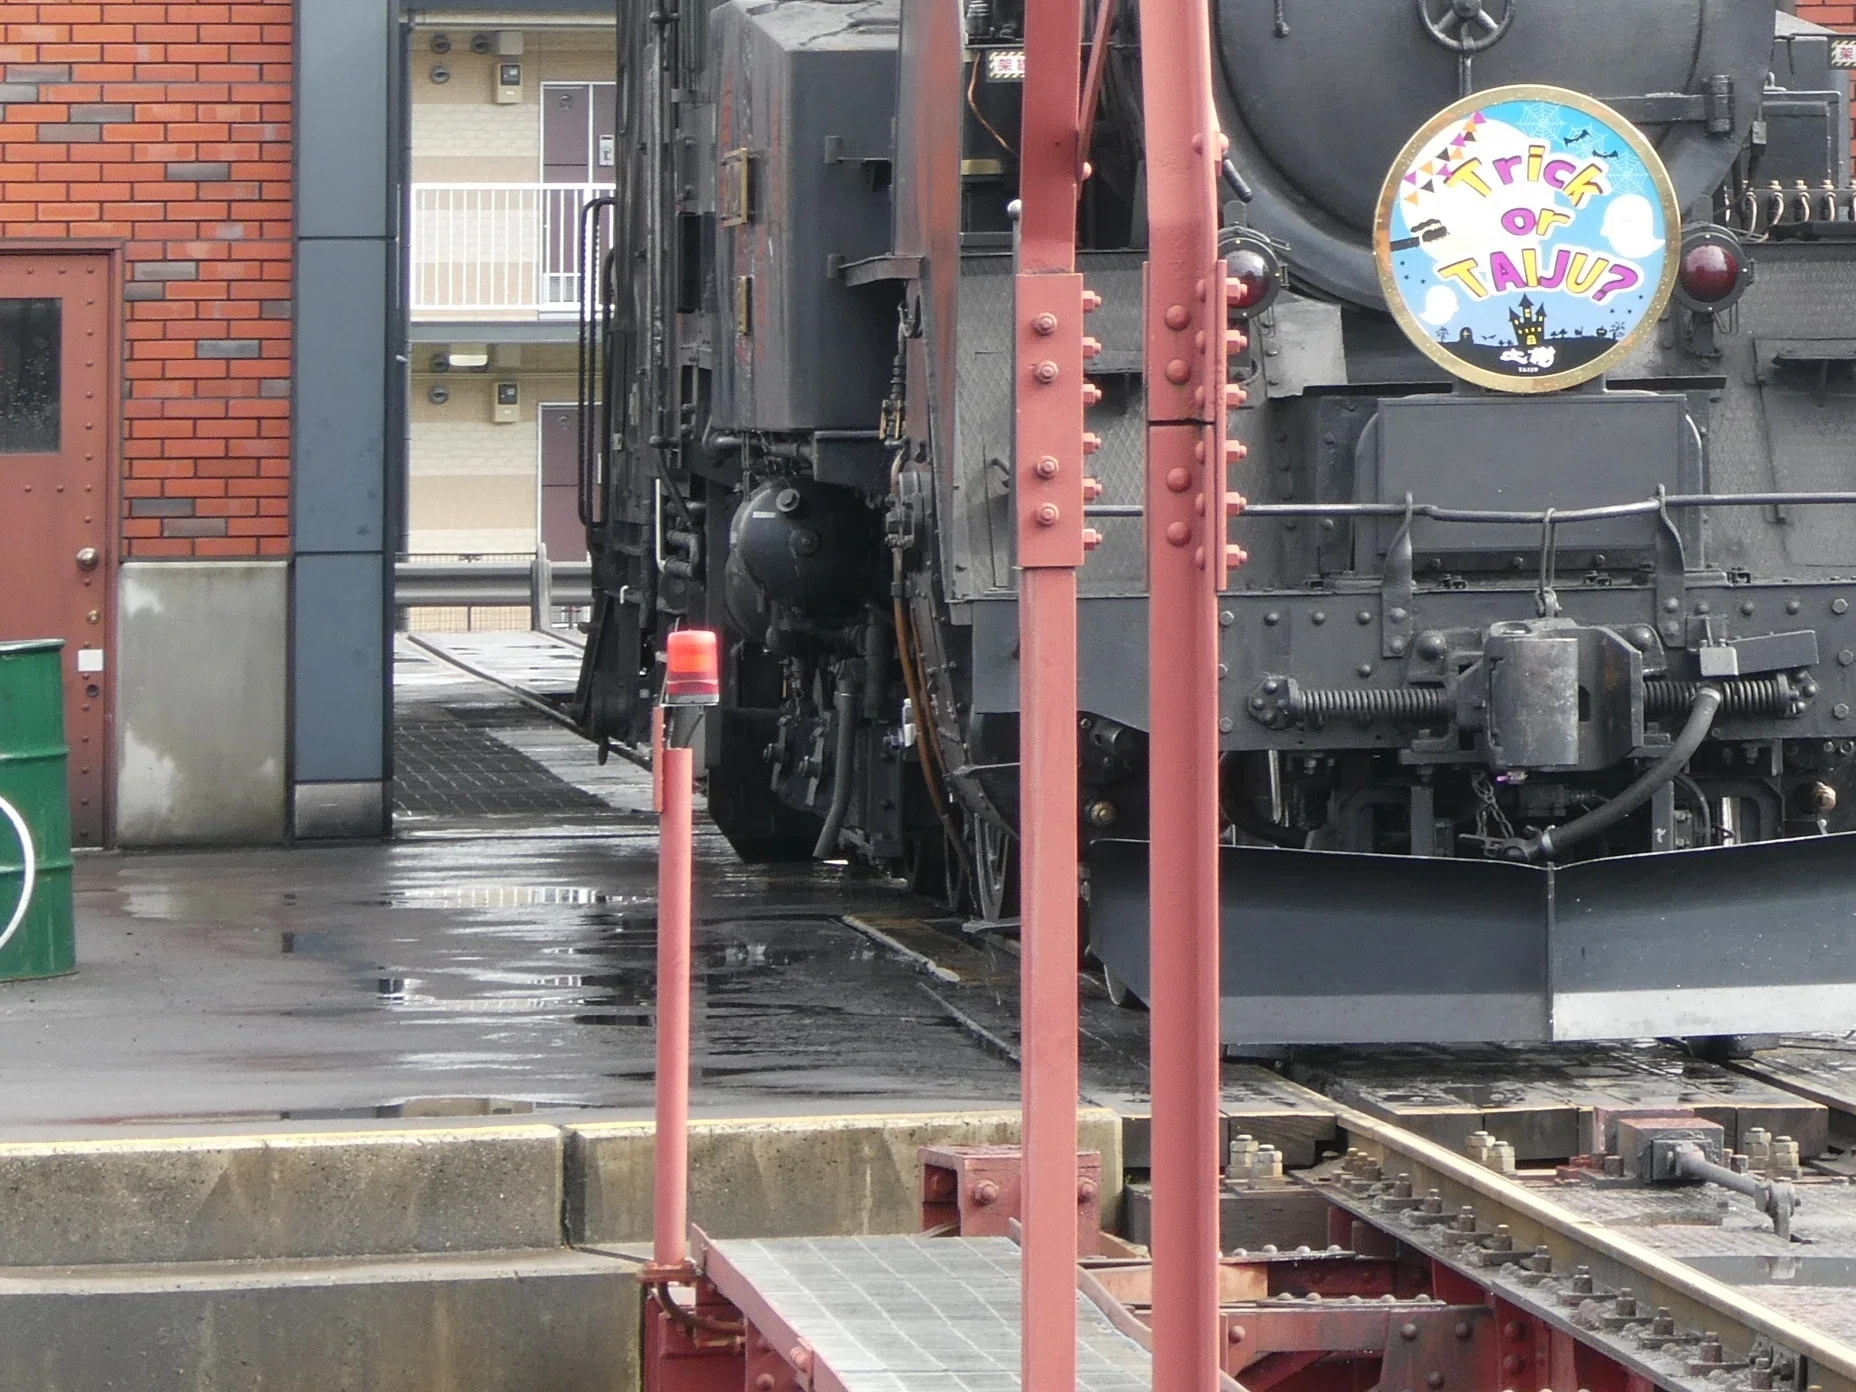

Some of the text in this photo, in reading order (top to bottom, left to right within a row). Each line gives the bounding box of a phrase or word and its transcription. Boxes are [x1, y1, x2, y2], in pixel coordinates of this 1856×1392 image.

[1443, 145, 1604, 207] Trick
[1501, 207, 1571, 236] or
[1437, 248, 1639, 302] TAIJU?
